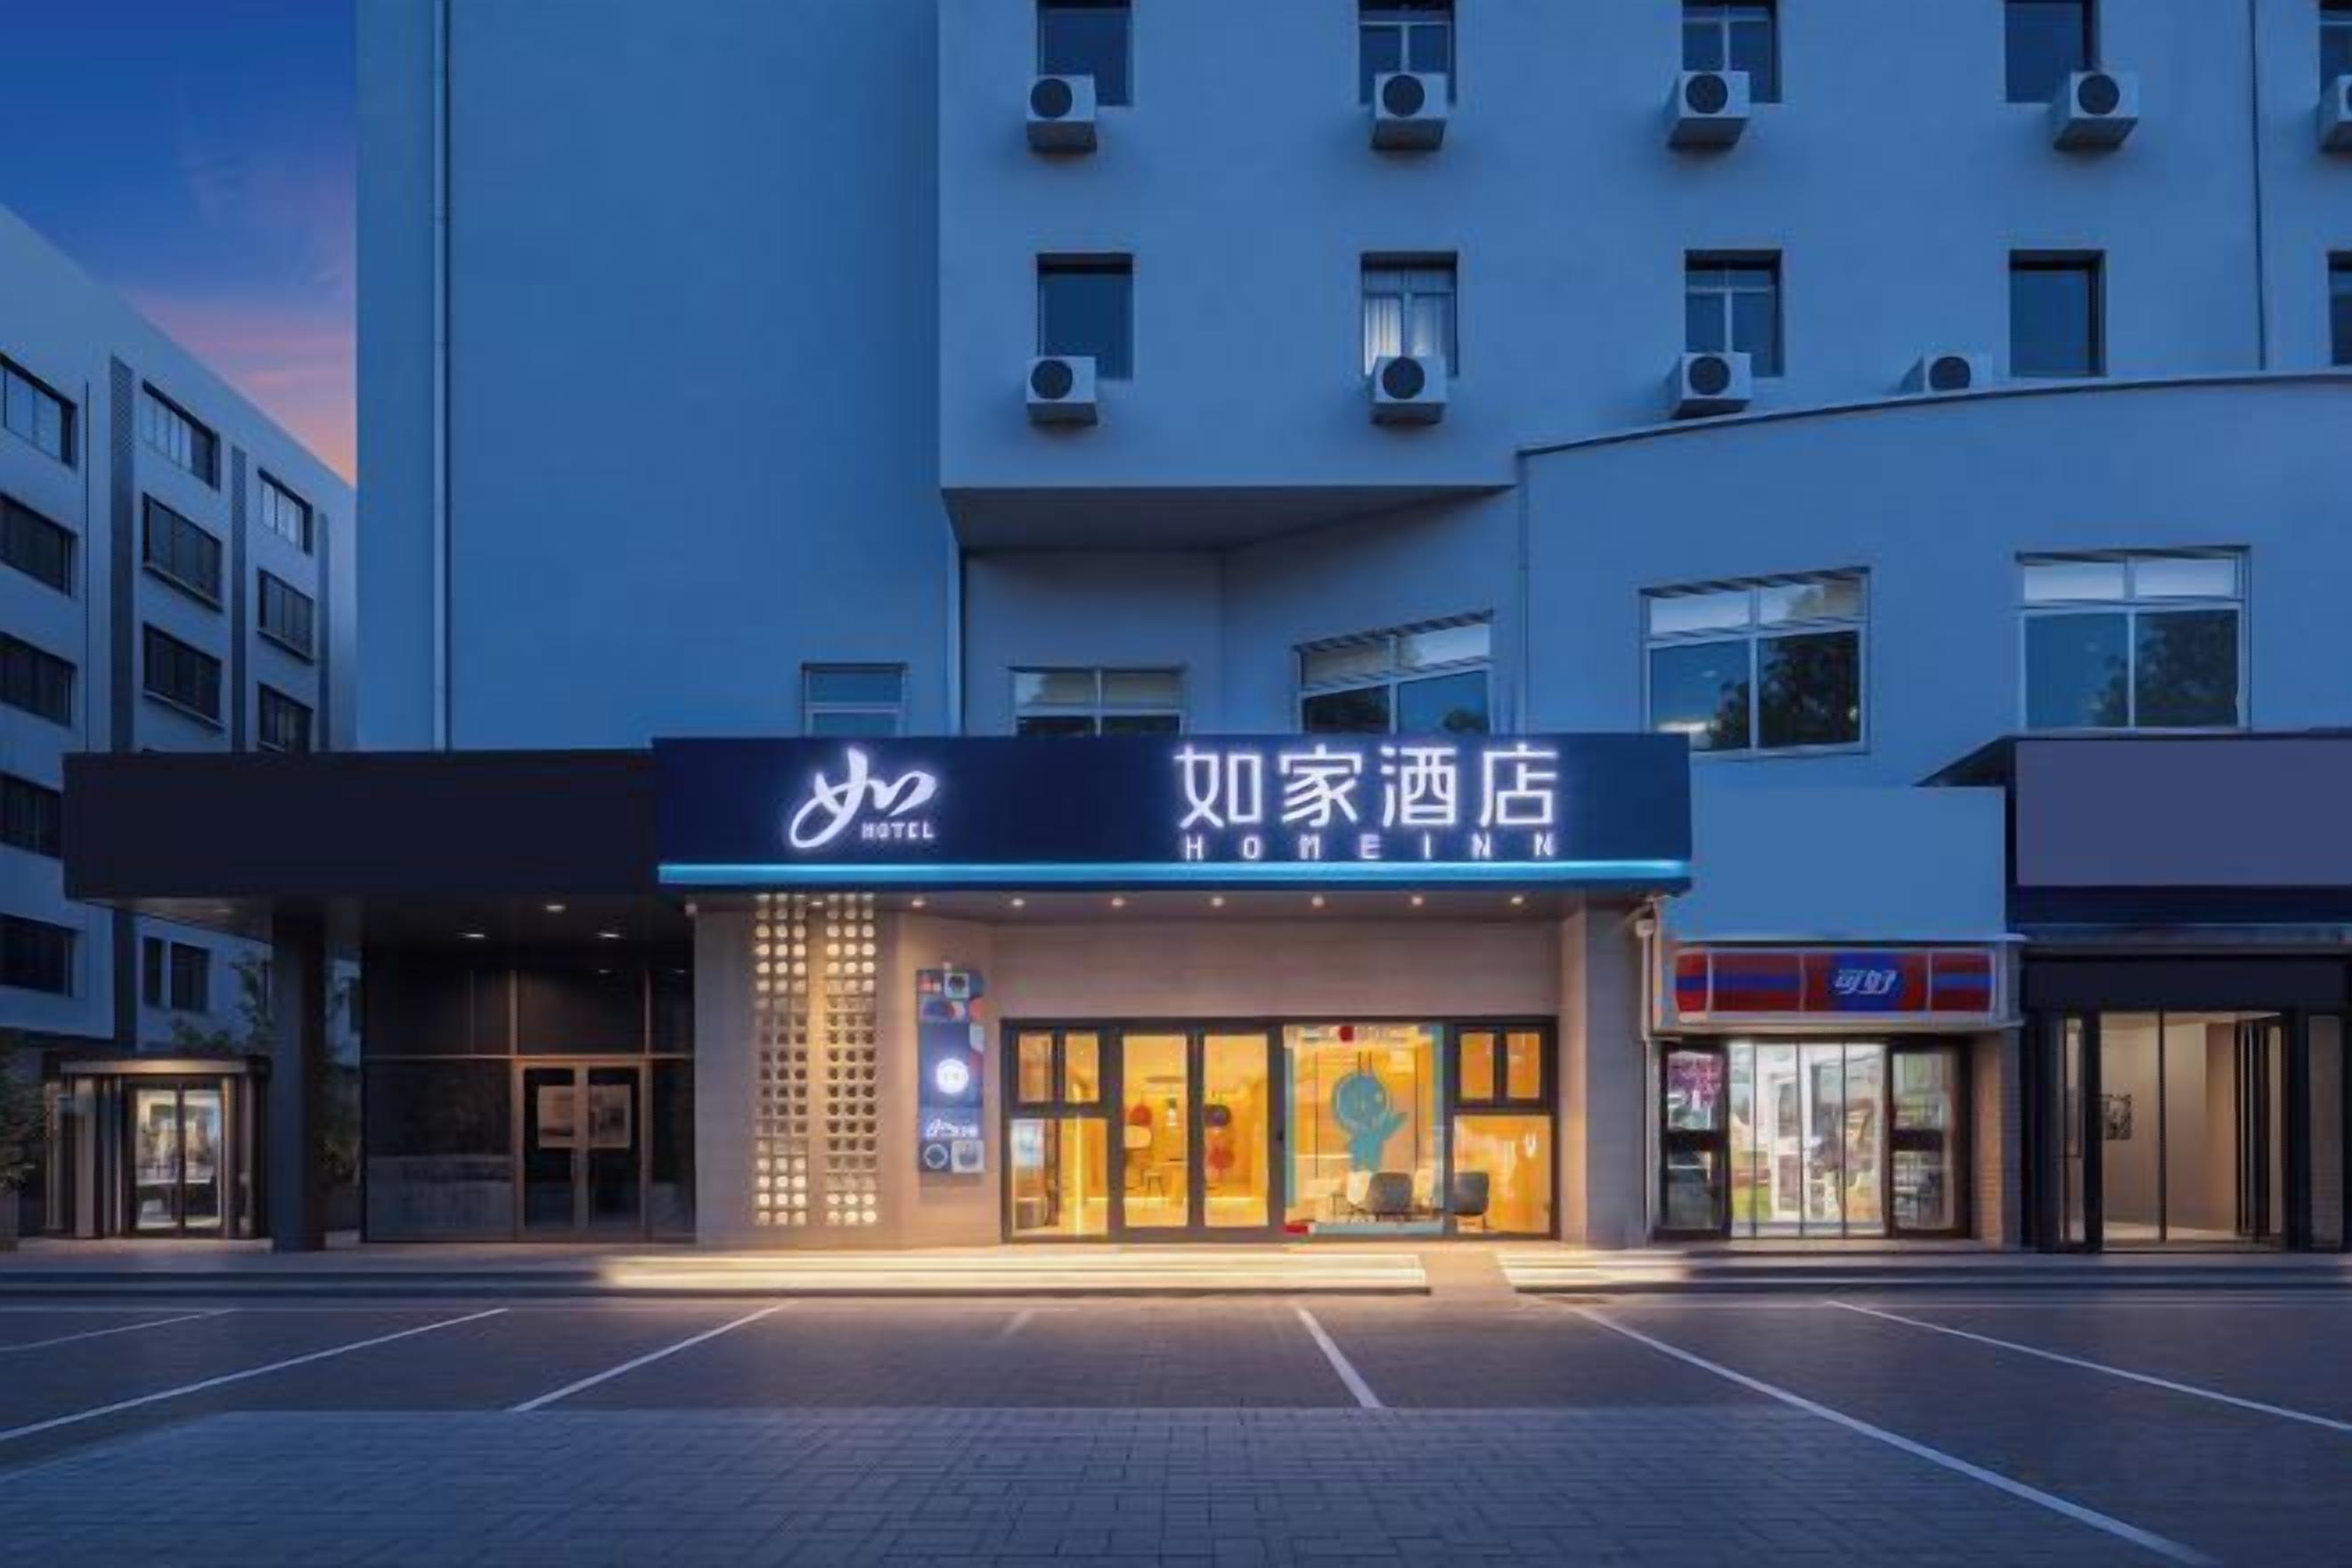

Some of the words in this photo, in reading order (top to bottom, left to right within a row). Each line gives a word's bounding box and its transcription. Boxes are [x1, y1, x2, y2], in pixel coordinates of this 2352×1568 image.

[1174, 744, 1558, 829] 如家酒店
[862, 821, 934, 839] HOTEL
